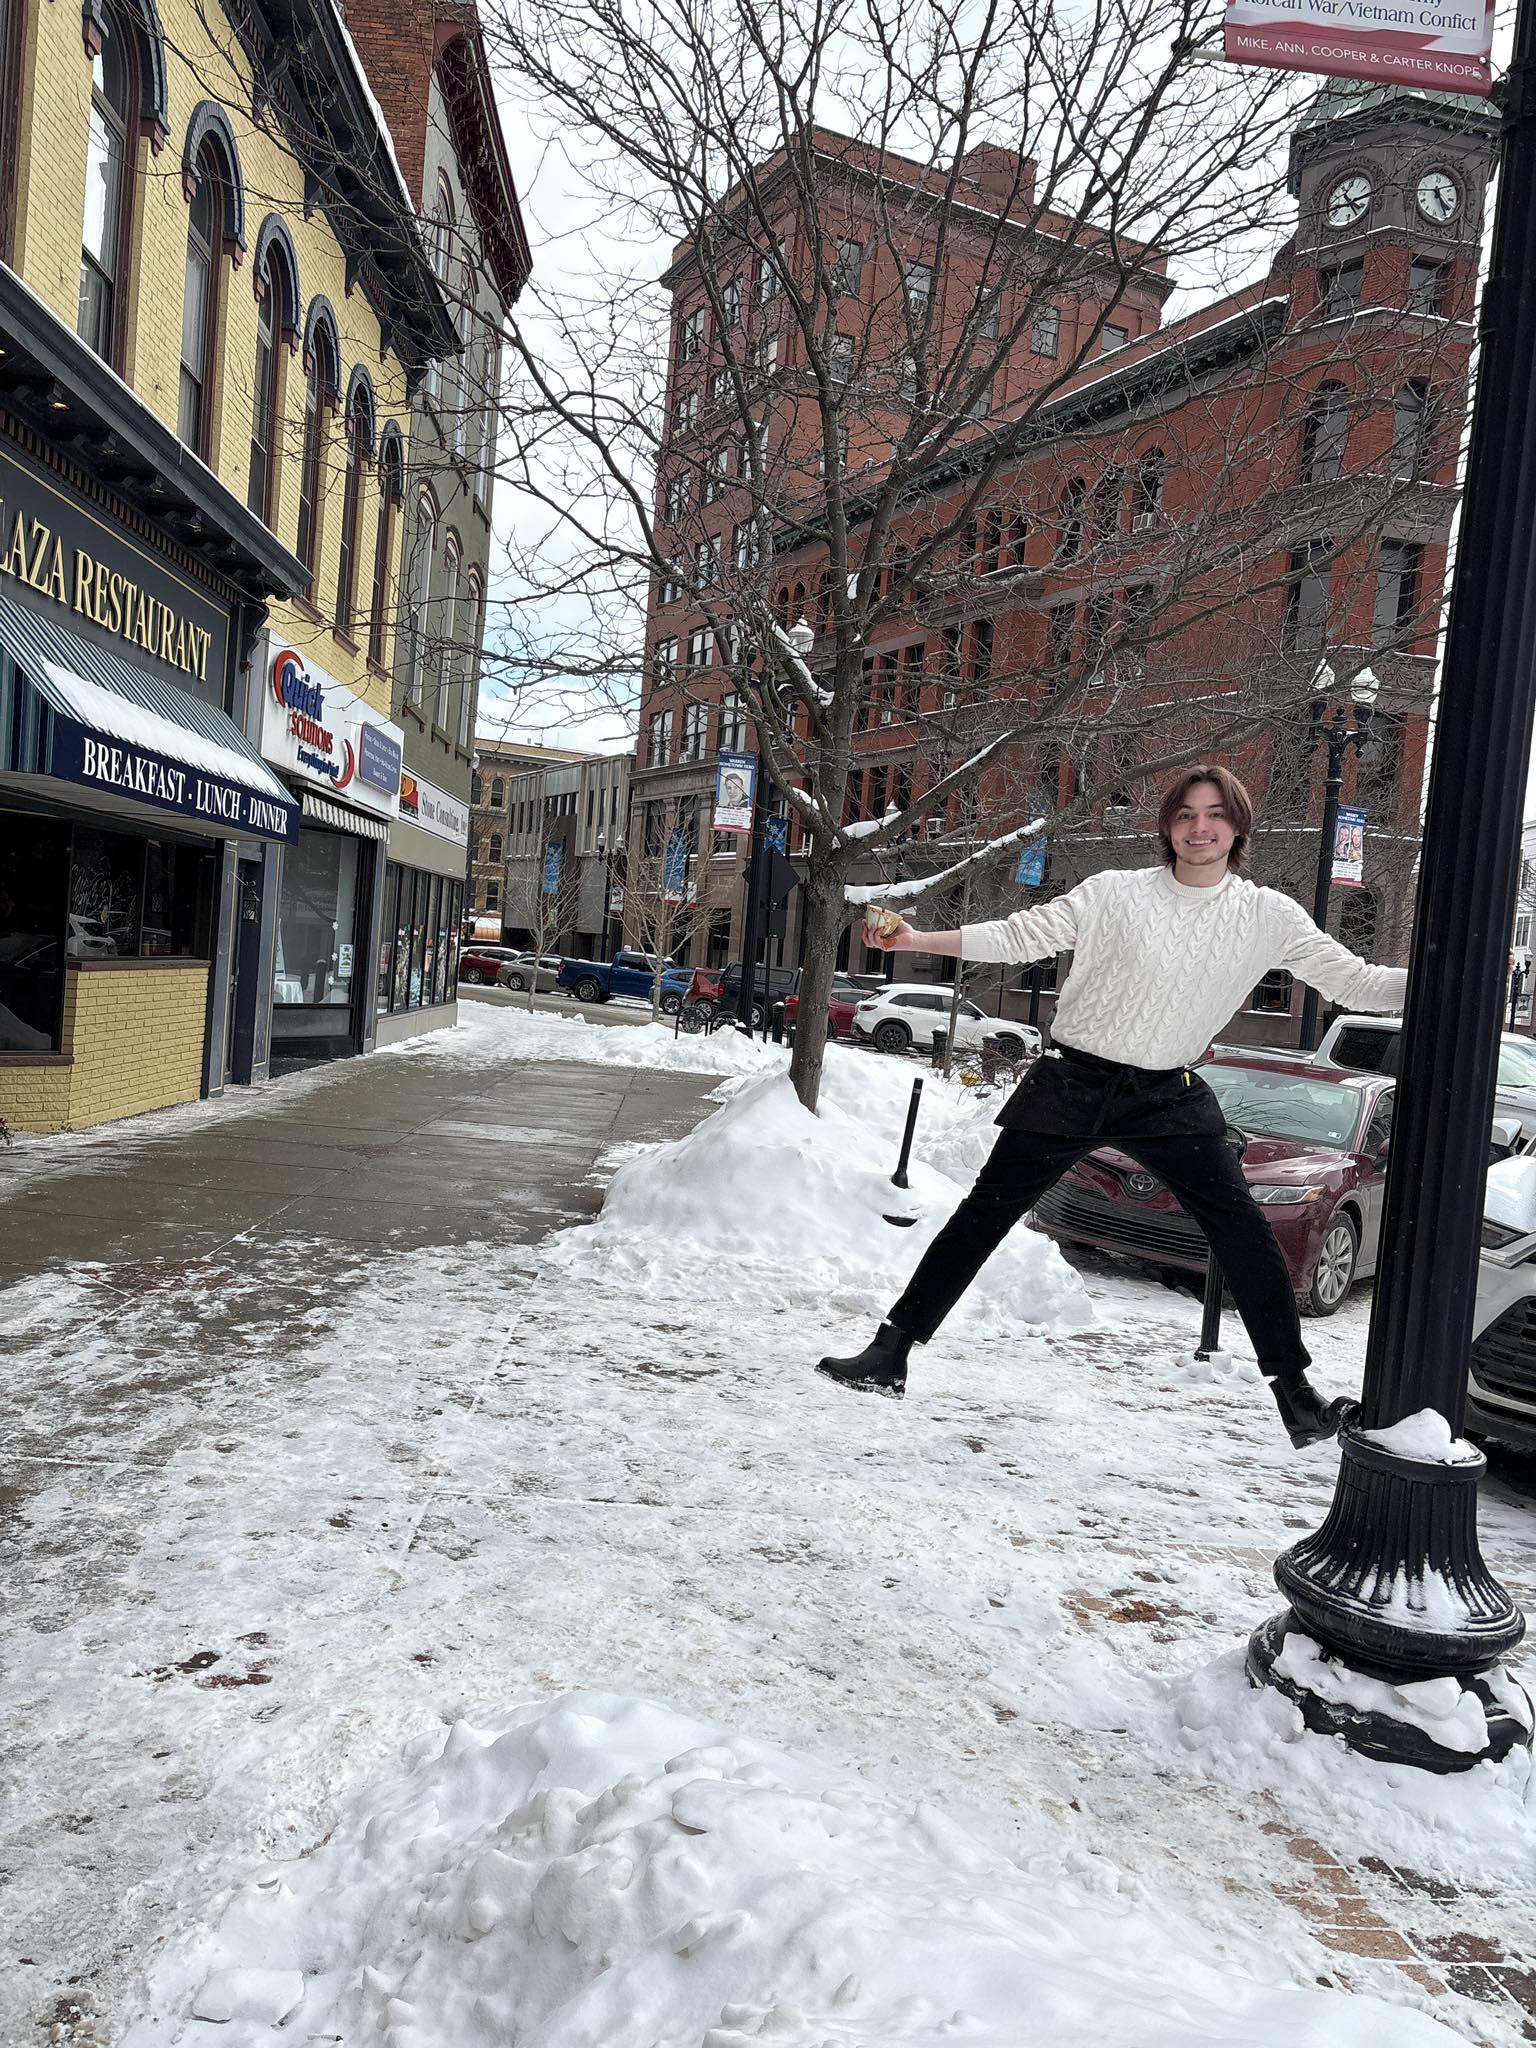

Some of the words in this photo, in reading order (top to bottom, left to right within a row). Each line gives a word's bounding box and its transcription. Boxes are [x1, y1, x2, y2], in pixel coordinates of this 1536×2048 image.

[1245, 0, 1302, 9] ean
[1309, 0, 1414, 24] War/Vietnam
[1237, 35, 1272, 52] MIKE,
[1275, 41, 1308, 56] ANN,
[1311, 45, 1368, 62] COOPER
[1370, 52, 1381, 63] &
[1383, 54, 1433, 71] CARTER
[73, 548, 212, 681] RESTAURANT
[282, 661, 325, 722] Quick
[291, 711, 334, 755] SOLUTIONS
[82, 736, 186, 804] BREAKFAST
[196, 779, 242, 821] LUNCH
[249, 797, 288, 835] DINNER
